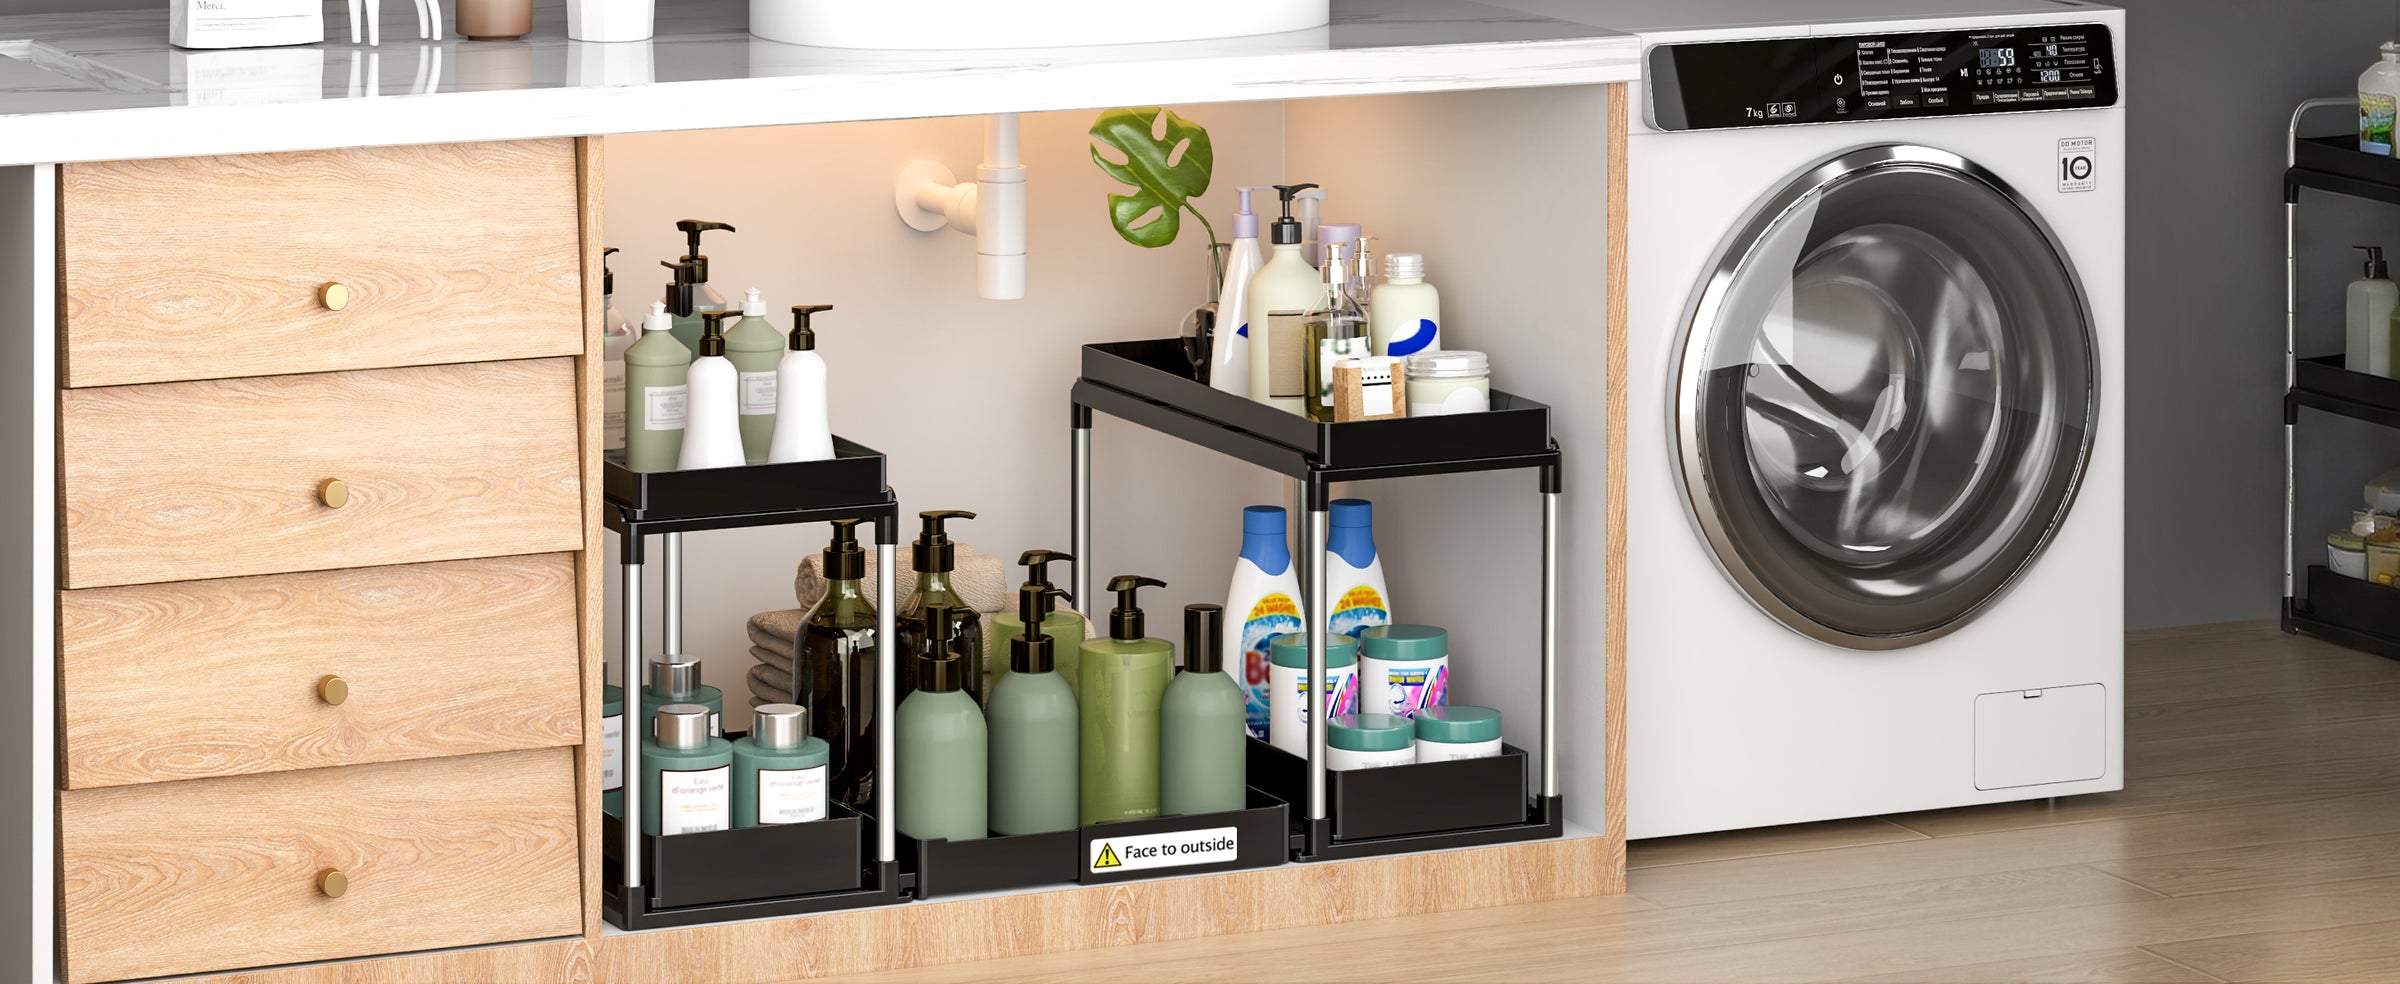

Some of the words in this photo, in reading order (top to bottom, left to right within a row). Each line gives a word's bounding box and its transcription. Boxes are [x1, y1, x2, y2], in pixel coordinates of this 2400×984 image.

[2045, 44, 2058, 56] 40
[2040, 69, 2060, 82] 1200
[2061, 155, 2092, 181] 10
[1125, 846, 1158, 859] Face
[1162, 843, 1177, 856] to
[1180, 836, 1235, 854] outside
